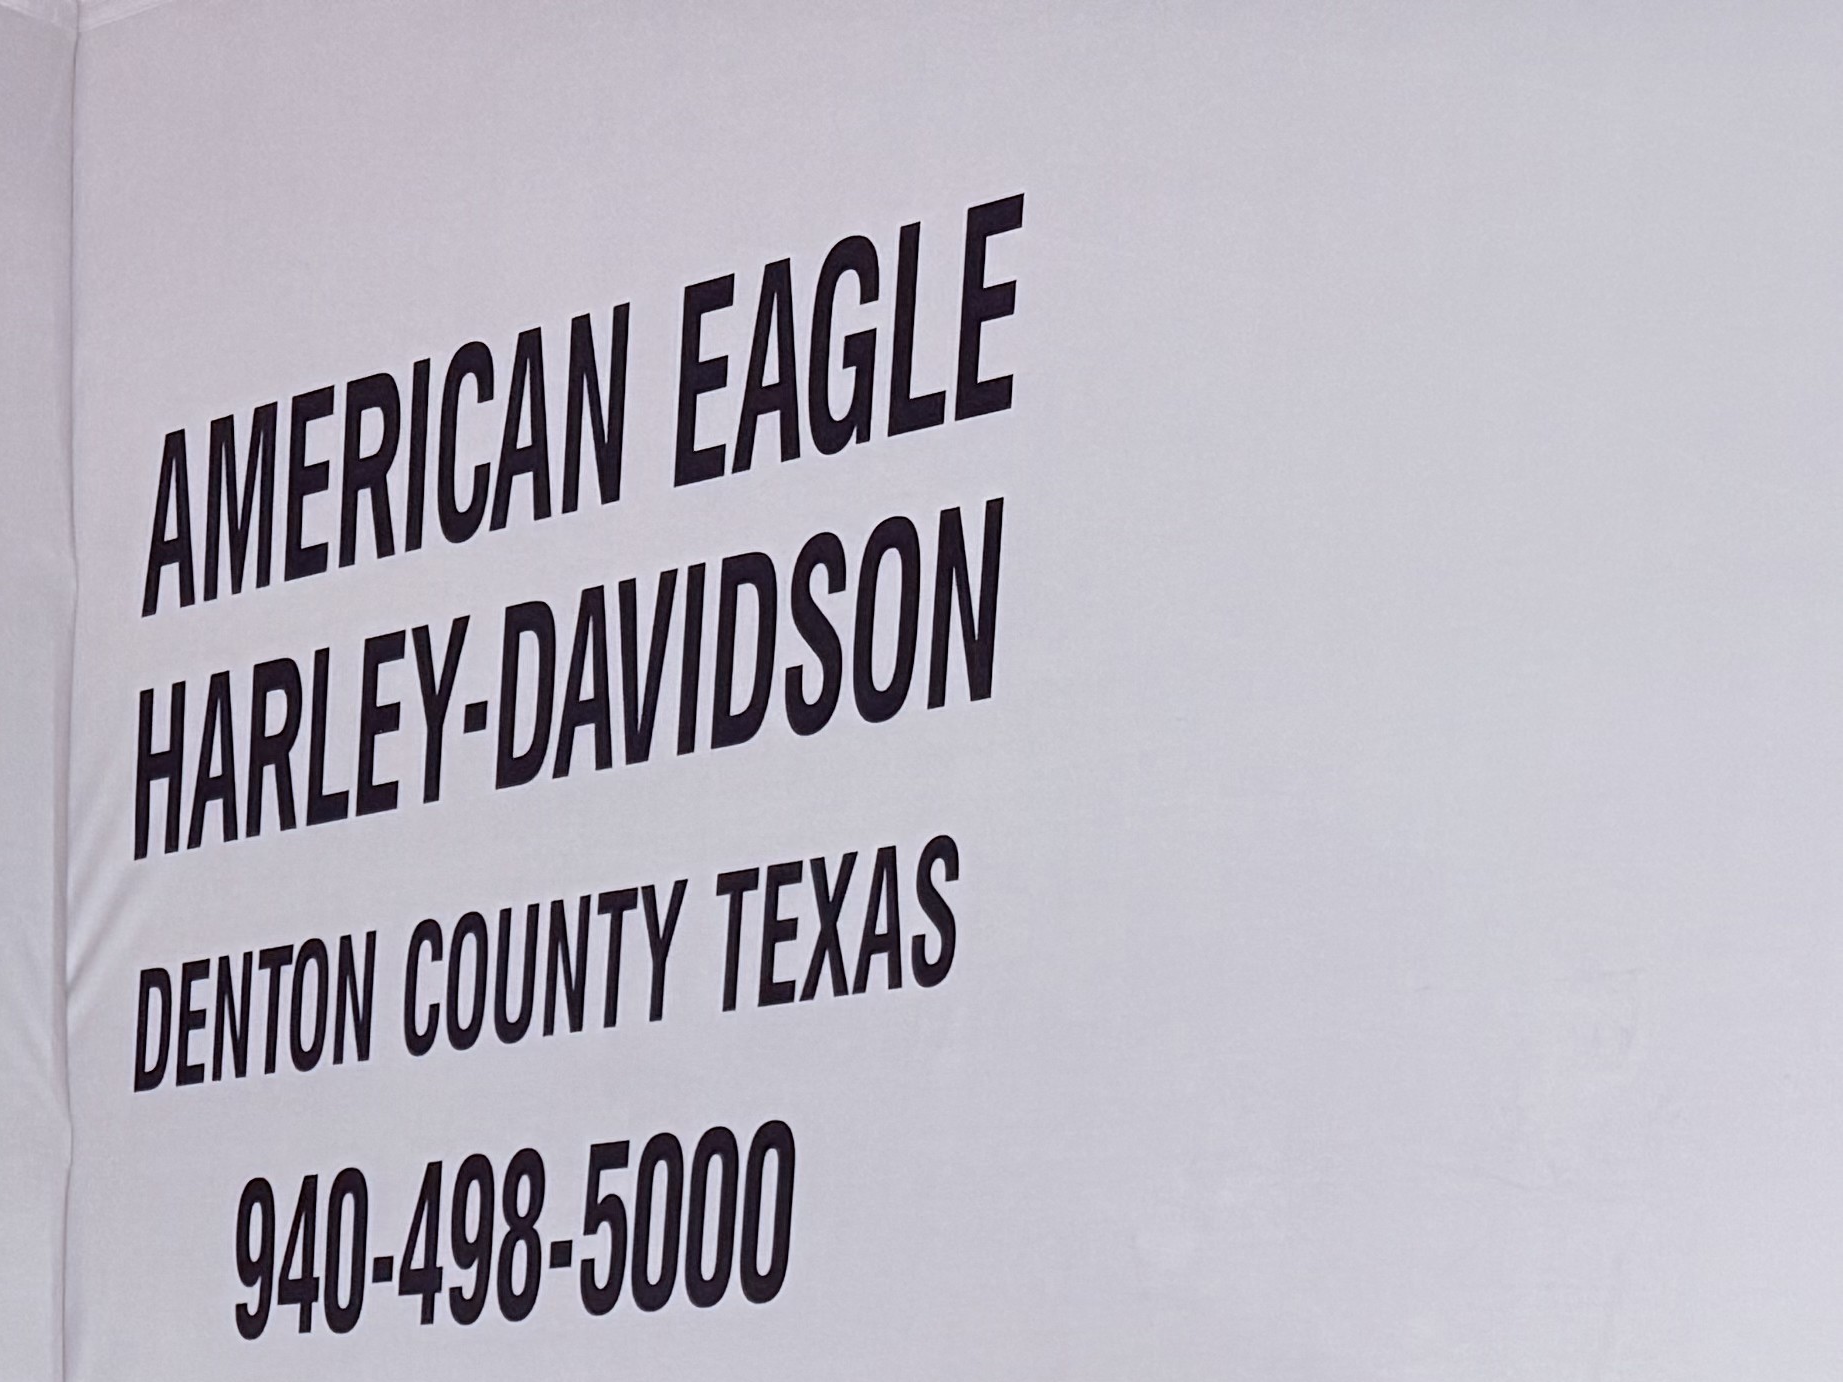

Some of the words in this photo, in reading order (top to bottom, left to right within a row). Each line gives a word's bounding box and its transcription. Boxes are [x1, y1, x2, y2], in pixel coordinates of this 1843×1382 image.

[142, 302, 630, 618] AMERICAN
[674, 193, 1025, 488] EAGLE
[134, 497, 1004, 860] HARLEY-DAVIDSON
[134, 931, 376, 1092] DENTON
[404, 879, 688, 1057] COUNTY
[715, 835, 960, 1012] TEXAS
[234, 1119, 796, 1341] 940-498-5000
